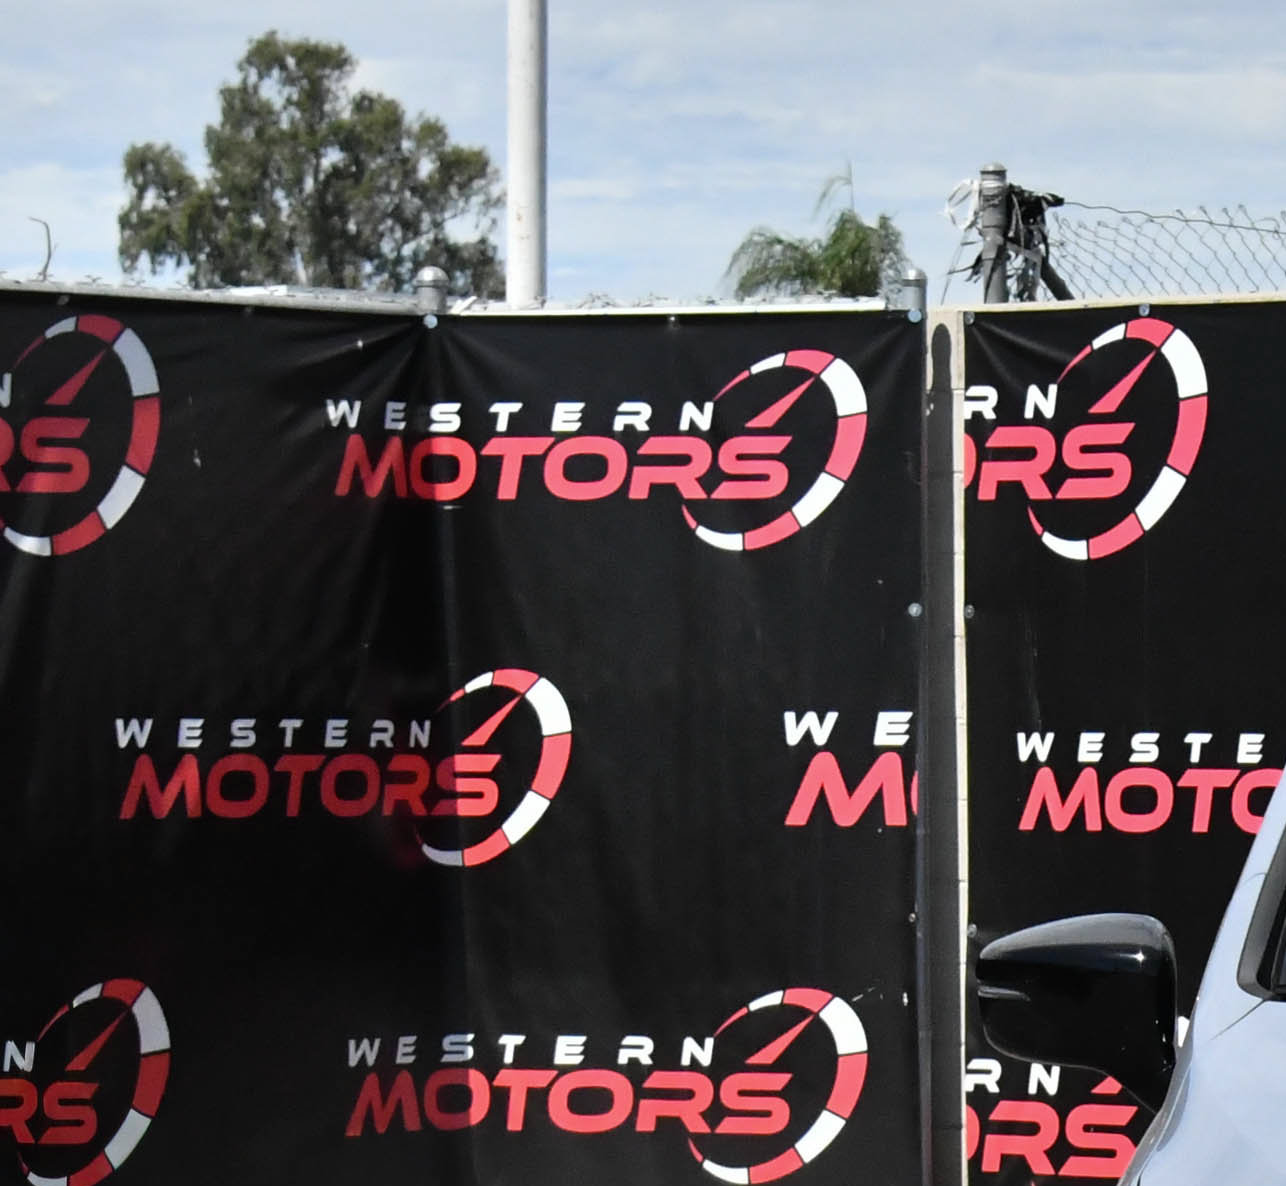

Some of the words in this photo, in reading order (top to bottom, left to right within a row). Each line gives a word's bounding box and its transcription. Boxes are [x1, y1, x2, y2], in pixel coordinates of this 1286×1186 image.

[326, 399, 715, 433] WESTERN
[335, 434, 793, 501] MOTORS
[965, 421, 1136, 501] RS
[115, 718, 432, 749] WESTERN
[120, 753, 502, 819] MOTORS
[348, 1033, 715, 1067] WESTERN
[345, 1069, 793, 1135] MOTORS
[966, 1100, 1139, 1179] RS
